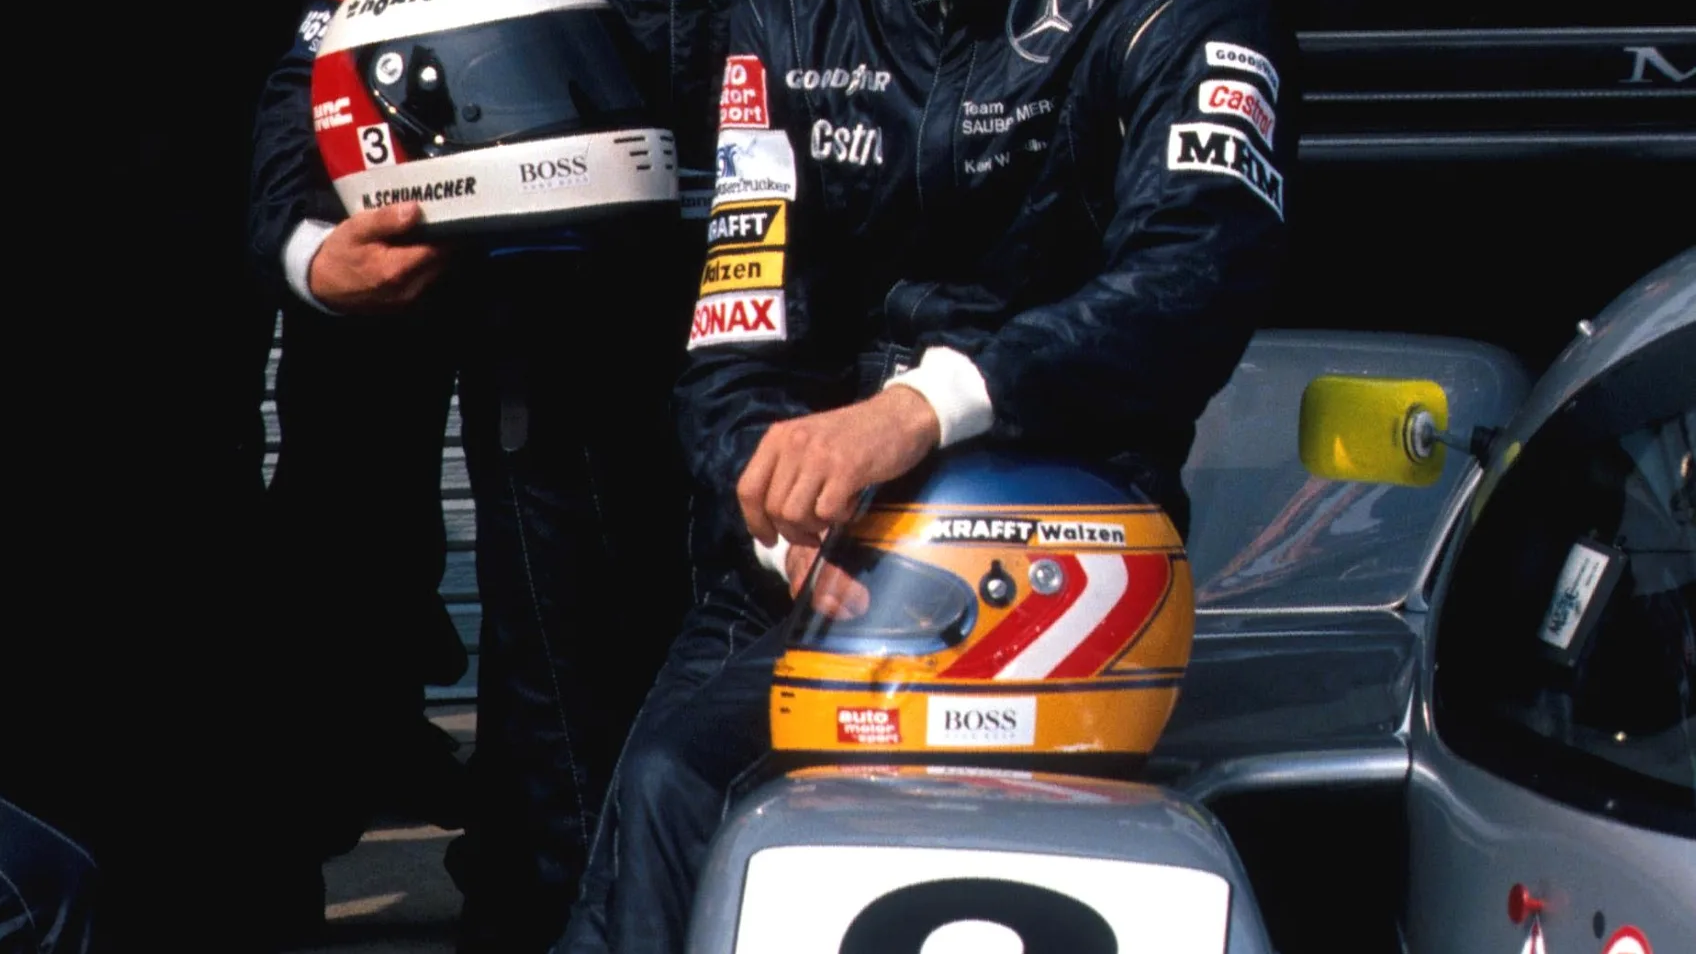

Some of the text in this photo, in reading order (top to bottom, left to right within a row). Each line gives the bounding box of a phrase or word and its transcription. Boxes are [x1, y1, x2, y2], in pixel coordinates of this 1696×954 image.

[963, 100, 1005, 117] Team
[362, 126, 389, 165] 3
[519, 155, 588, 184] BOSS
[933, 519, 1126, 544] KRAFFT Walzen
[837, 709, 890, 724] auto
[943, 708, 1018, 731] BOSS
